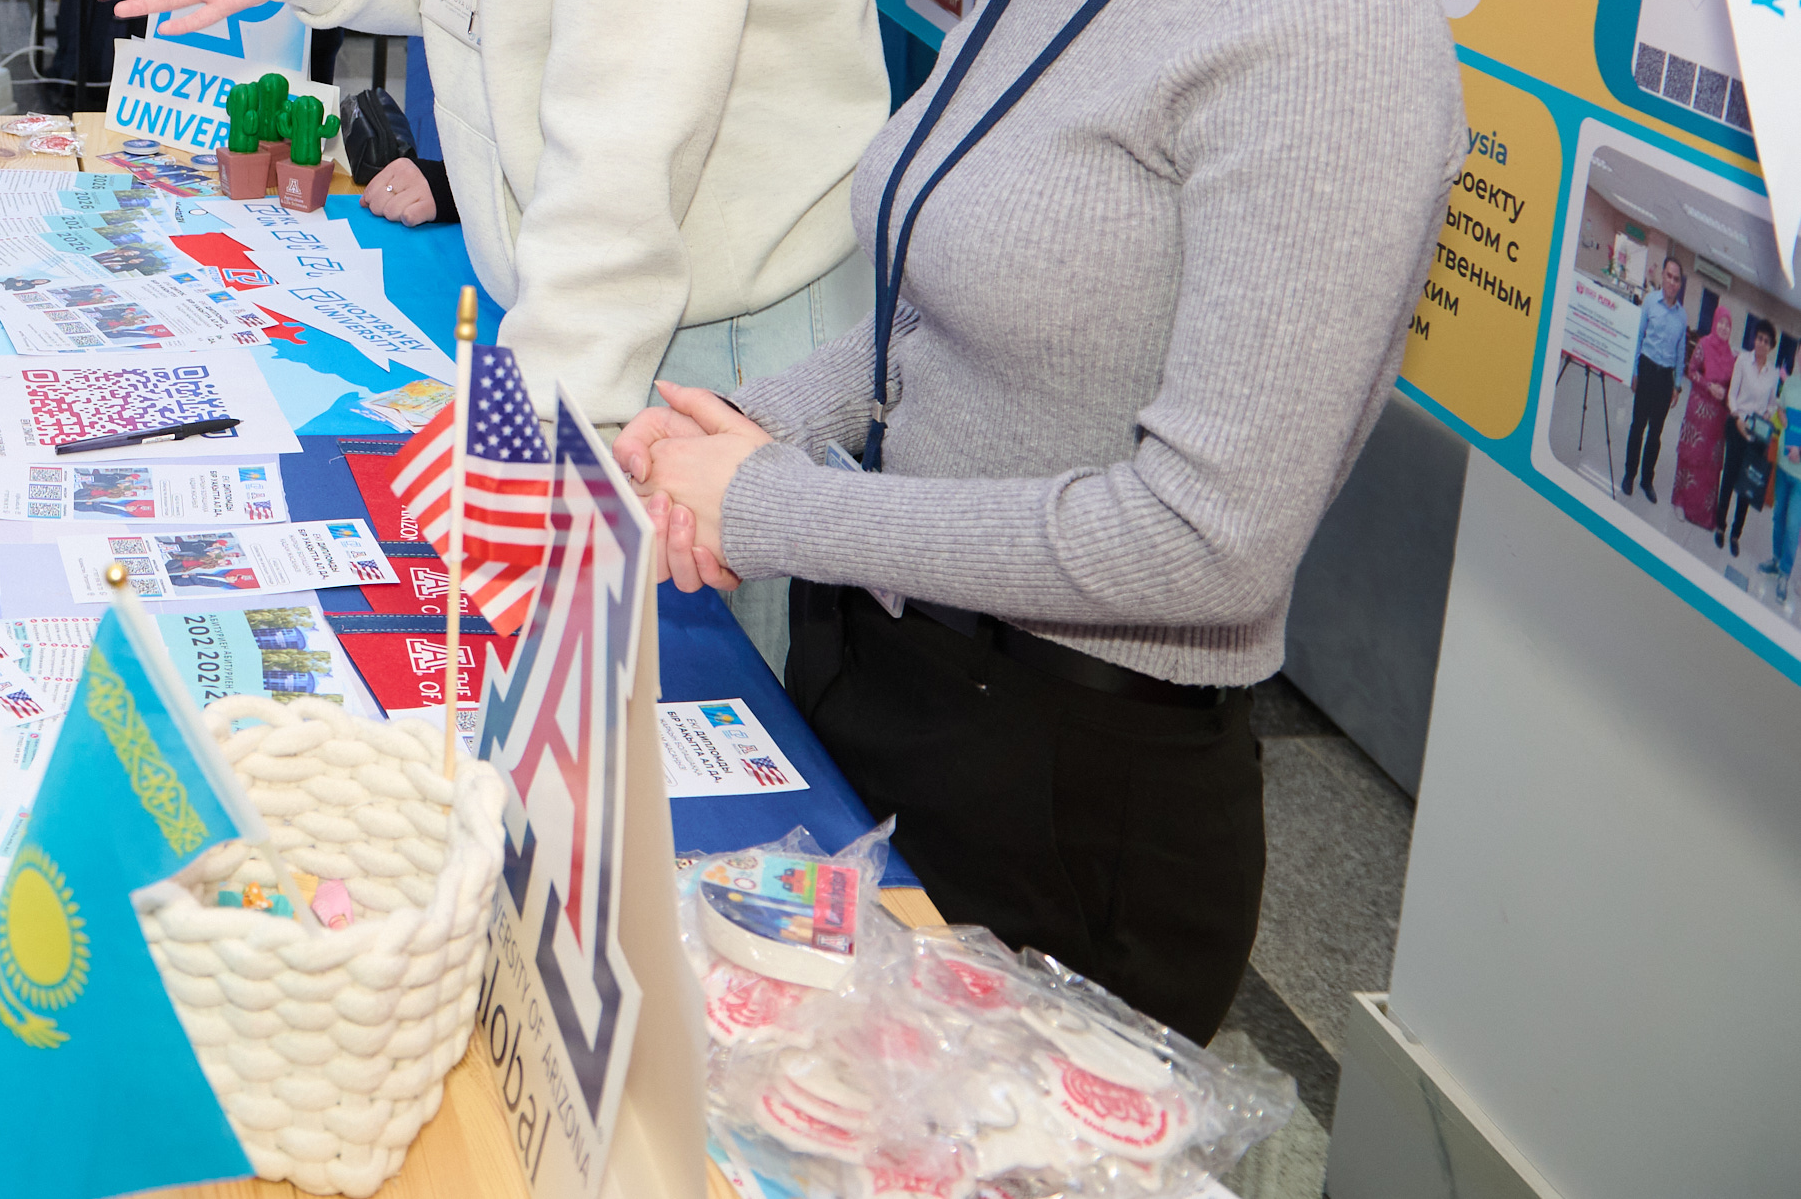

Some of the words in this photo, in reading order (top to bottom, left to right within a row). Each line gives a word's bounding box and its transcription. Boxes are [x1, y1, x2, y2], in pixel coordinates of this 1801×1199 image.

[75, 191, 95, 210] 2026
[57, 232, 91, 252] 2026
[1507, 241, 1519, 262] с
[314, 304, 407, 353] UNIVERSITY
[337, 302, 433, 352] KOZYBAYEV
[418, 681, 442, 699] OF
[667, 711, 681, 723] БІР
[677, 723, 705, 757] УАҚЫТТА
[700, 757, 715, 769] АЛ
[686, 718, 702, 730] ЕКІ
[694, 729, 733, 774] ДИПЛОМДЫ
[477, 959, 551, 1190] lobal
[528, 998, 545, 1043] OF
[541, 1043, 592, 1189] ARIZONA
